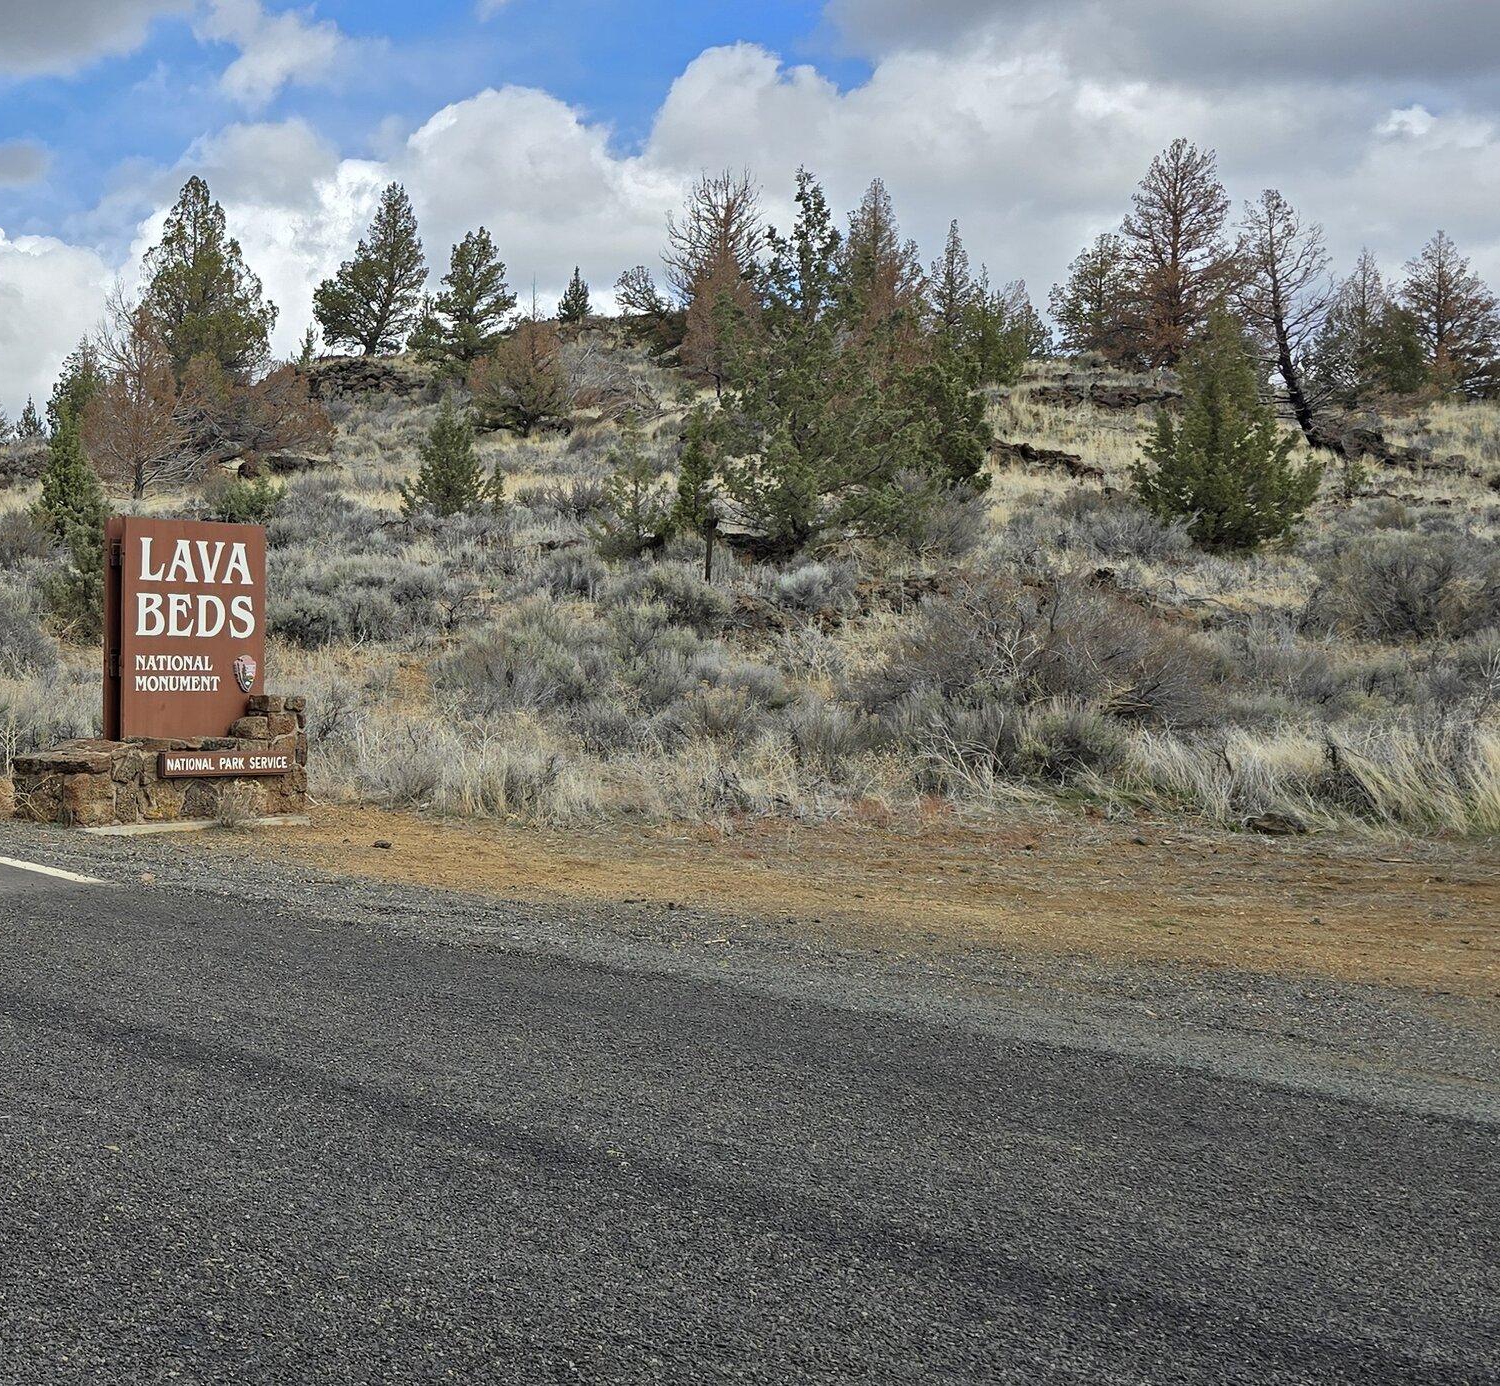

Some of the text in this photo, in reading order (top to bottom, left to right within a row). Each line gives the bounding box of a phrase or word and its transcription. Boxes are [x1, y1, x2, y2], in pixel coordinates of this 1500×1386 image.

[139, 537, 254, 585] LAVA
[135, 593, 256, 639] BEDS
[135, 655, 214, 672] NATIONAL
[135, 675, 221, 692] MONUMENT
[166, 756, 288, 771] NATIONAL PARK SERVICE
